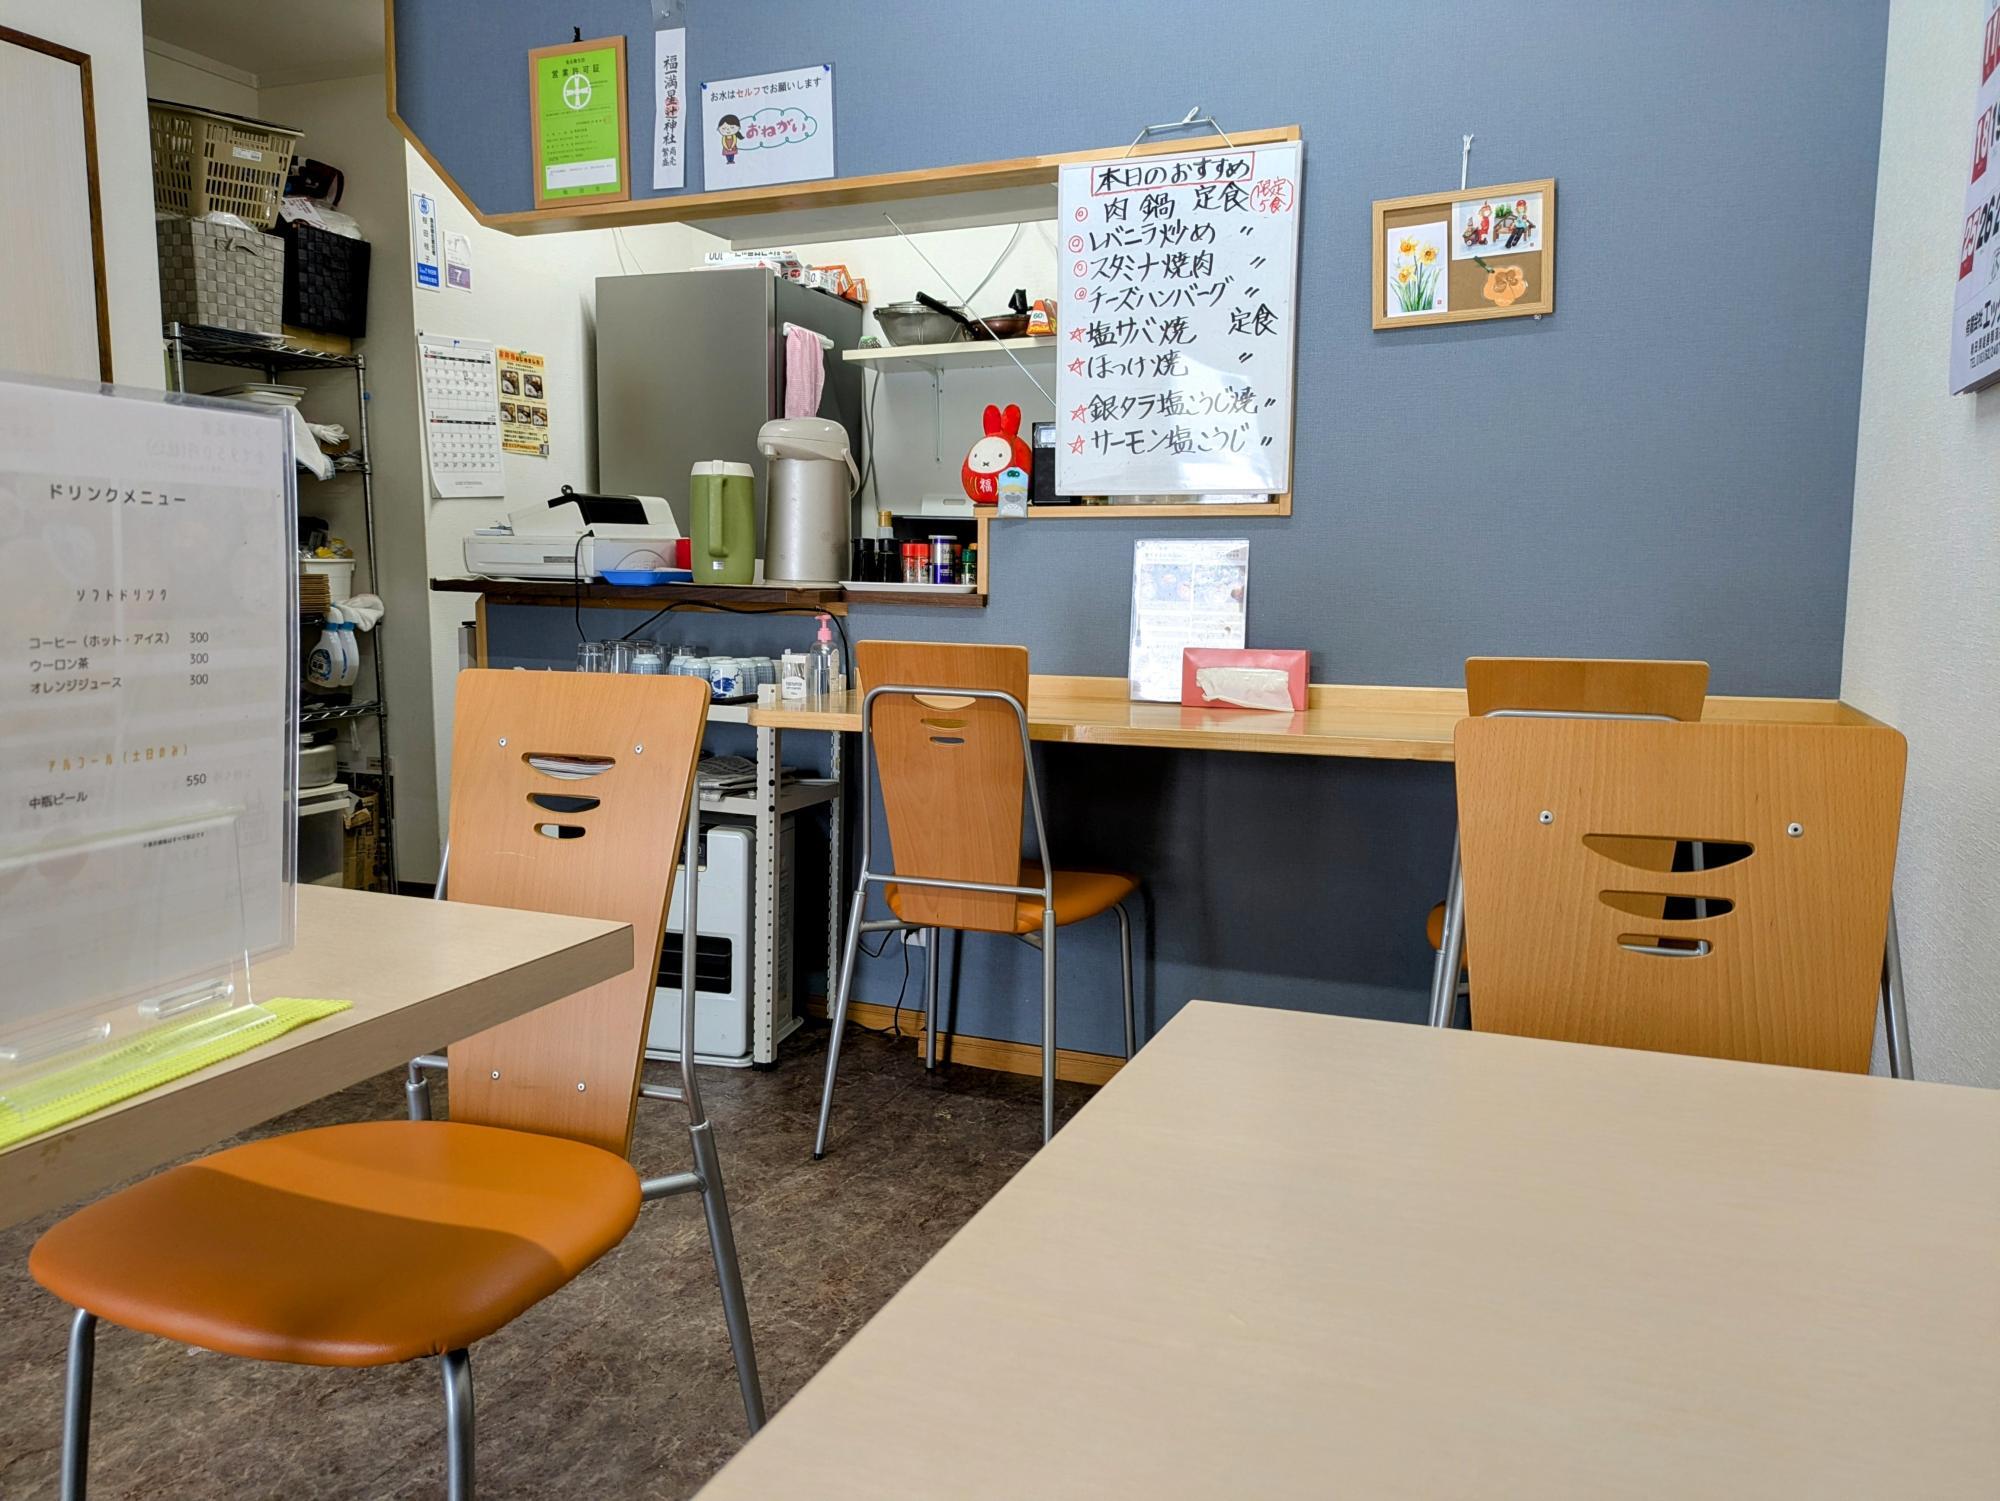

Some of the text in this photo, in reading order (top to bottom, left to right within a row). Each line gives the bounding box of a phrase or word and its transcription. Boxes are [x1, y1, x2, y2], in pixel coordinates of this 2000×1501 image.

[710, 76, 821, 102] お水はセルフでお願いします
[746, 118, 806, 139] おねがい
[1096, 156, 1251, 193] 本日のおすすめ
[1192, 180, 1251, 213] 定食
[1089, 218, 1216, 252] レバニラ炒め
[1975, 194, 1995, 251] 26
[454, 269, 463, 283] 7
[1090, 249, 1215, 281] スタミナ焼肉
[1088, 275, 1236, 313] チーズハンバーグ
[1086, 303, 1279, 348] 塩サバ焼 定食
[1087, 349, 1189, 379] ほっけ焼
[1087, 386, 1259, 423] 銀タラ塩こうじ焼
[1090, 422, 1251, 456] サーモン塩こうじ
[50, 483, 186, 506] ドリンクメニュー
[979, 478, 993, 493] 福
[76, 589, 167, 602] ソフトドリンク
[189, 631, 209, 644] 300
[30, 653, 209, 672] ウーロン茶 300
[30, 673, 209, 695] オレンジジュース 300
[186, 772, 207, 788] 550
[28, 791, 88, 810] 中瓶ビール
